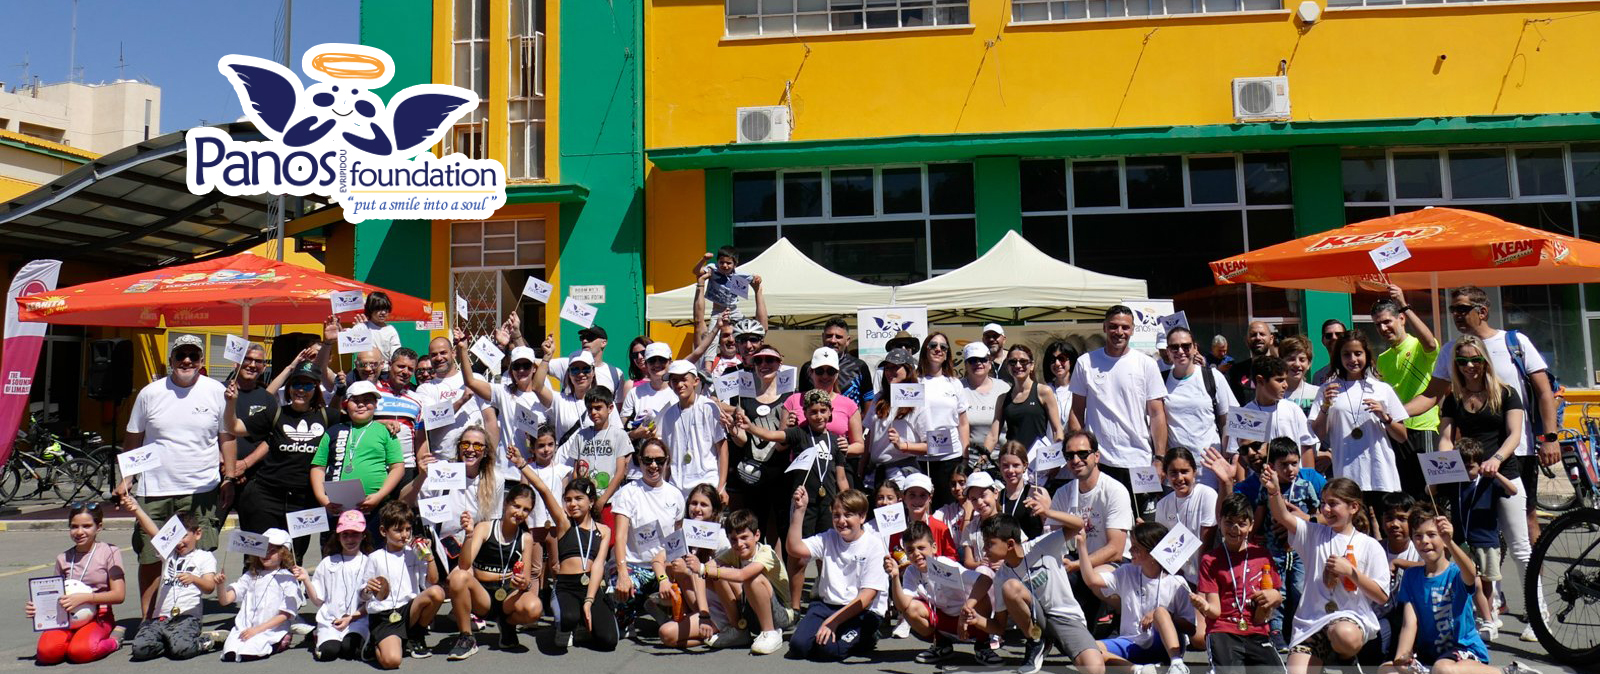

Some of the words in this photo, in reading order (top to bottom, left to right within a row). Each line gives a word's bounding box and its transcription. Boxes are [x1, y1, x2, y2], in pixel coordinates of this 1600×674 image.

[1491, 239, 1533, 260] KEAN
[1215, 260, 1248, 276] KEAN
[866, 329, 892, 339] Panos
[1135, 325, 1151, 333] anos
[586, 439, 610, 447] SUPER
[582, 446, 613, 456] MARIO
